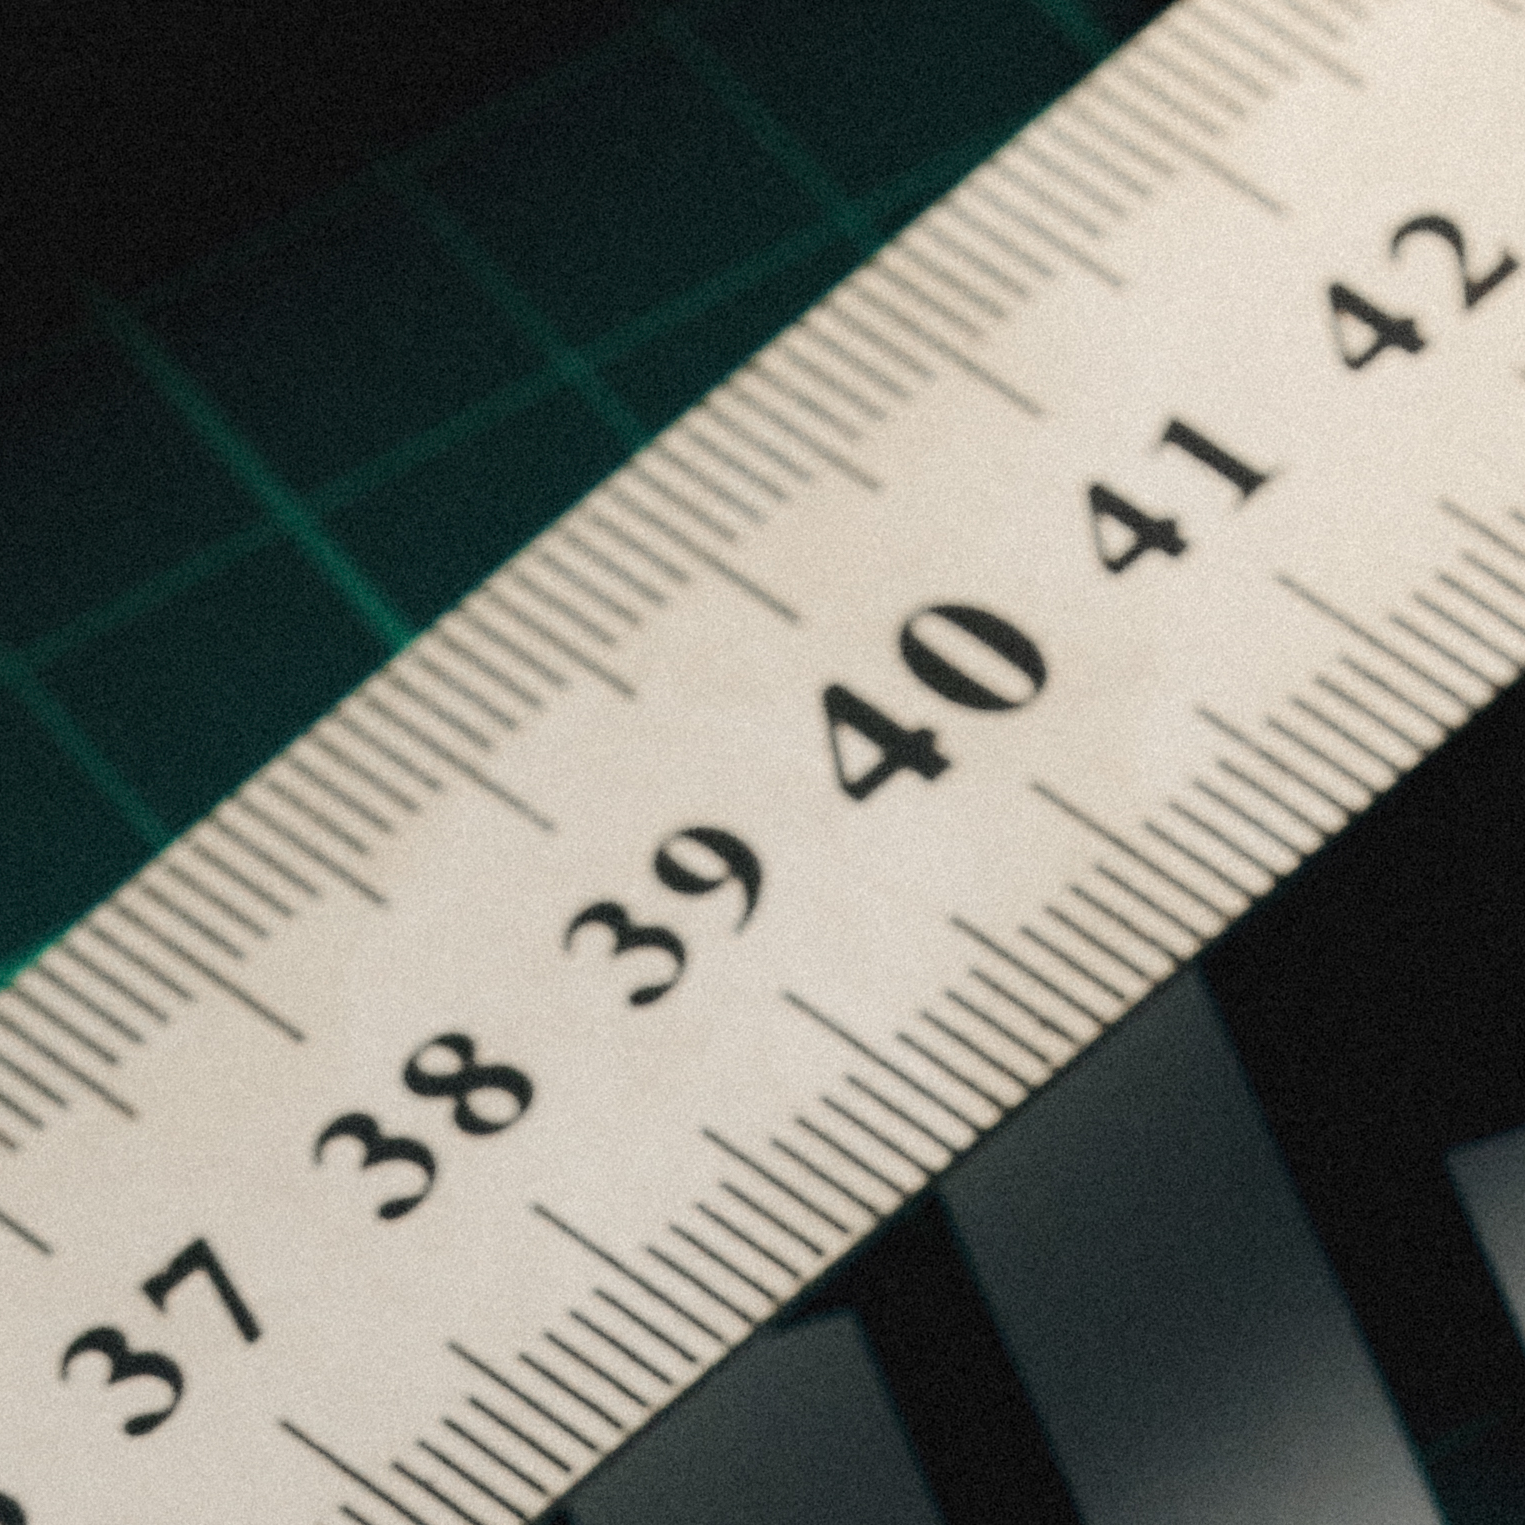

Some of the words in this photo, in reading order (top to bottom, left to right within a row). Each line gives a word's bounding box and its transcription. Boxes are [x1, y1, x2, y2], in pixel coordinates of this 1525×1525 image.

[60, 1237, 262, 1437] 37
[313, 1032, 535, 1222] 38
[562, 826, 764, 1007] 39
[822, 603, 1048, 801] 40
[1087, 418, 1281, 575] 41
[1326, 214, 1520, 371] 42
